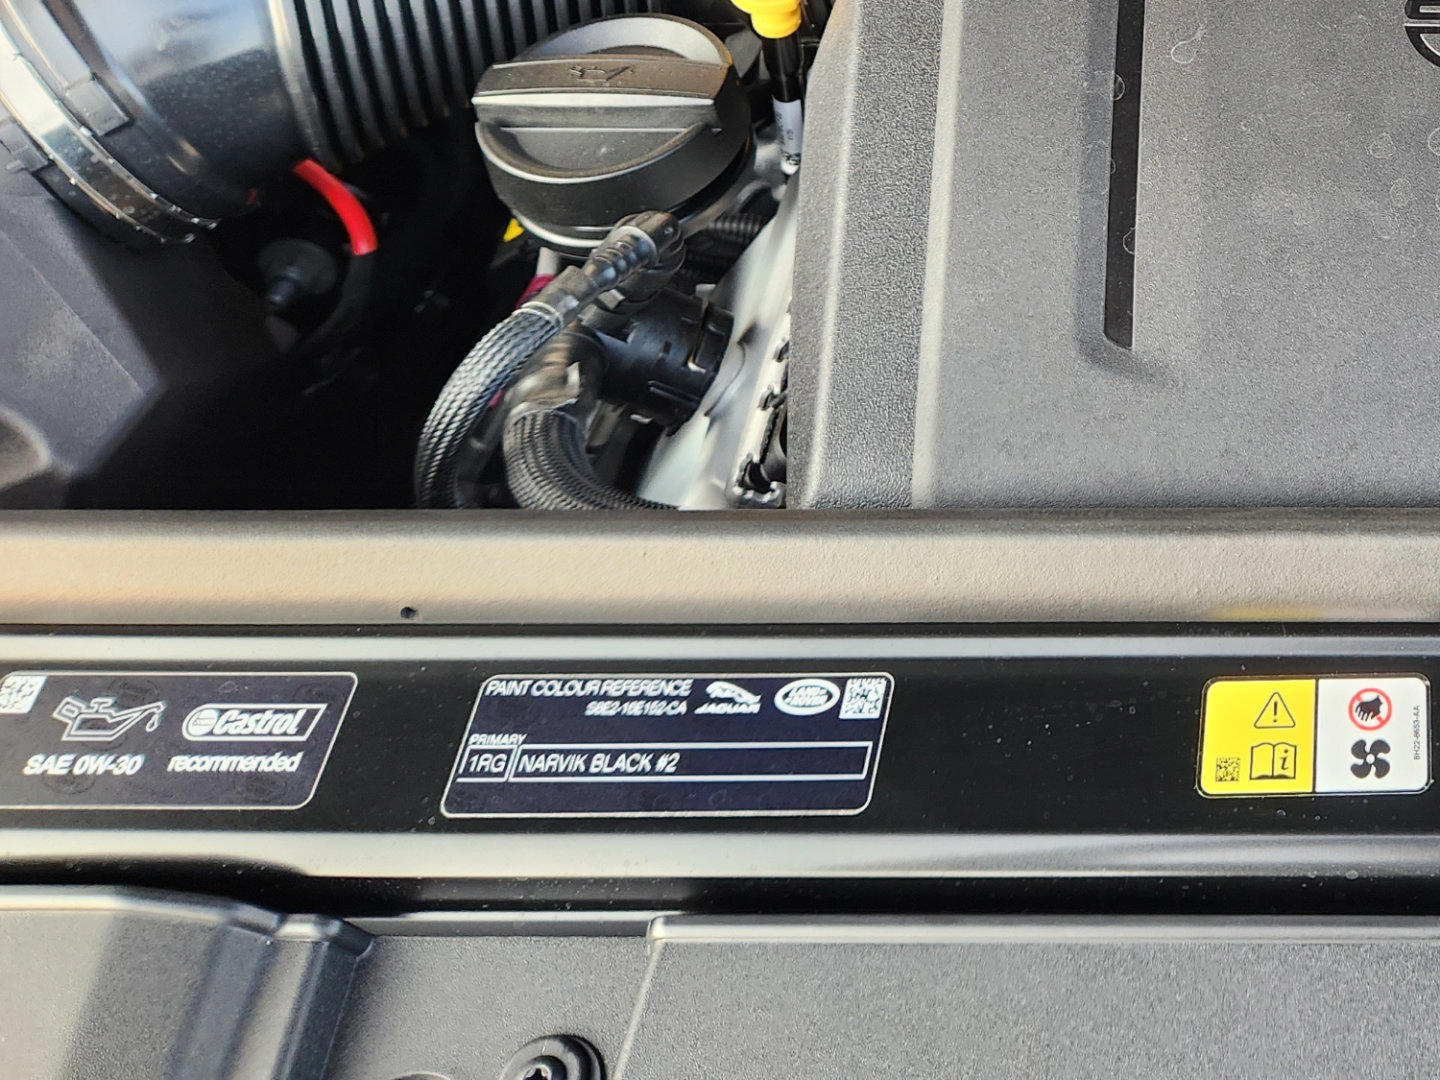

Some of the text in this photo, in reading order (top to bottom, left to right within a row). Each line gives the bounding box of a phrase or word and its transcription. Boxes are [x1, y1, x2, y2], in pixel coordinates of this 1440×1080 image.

[485, 679, 694, 697] PAINT COLOUR REFERENCE
[212, 708, 309, 737] Castrol
[468, 733, 527, 746] PRIMARY
[23, 753, 146, 776] SAE 0W-30
[167, 751, 305, 773] recommended
[468, 753, 681, 774] 1RG NARVIK BLACK #2
